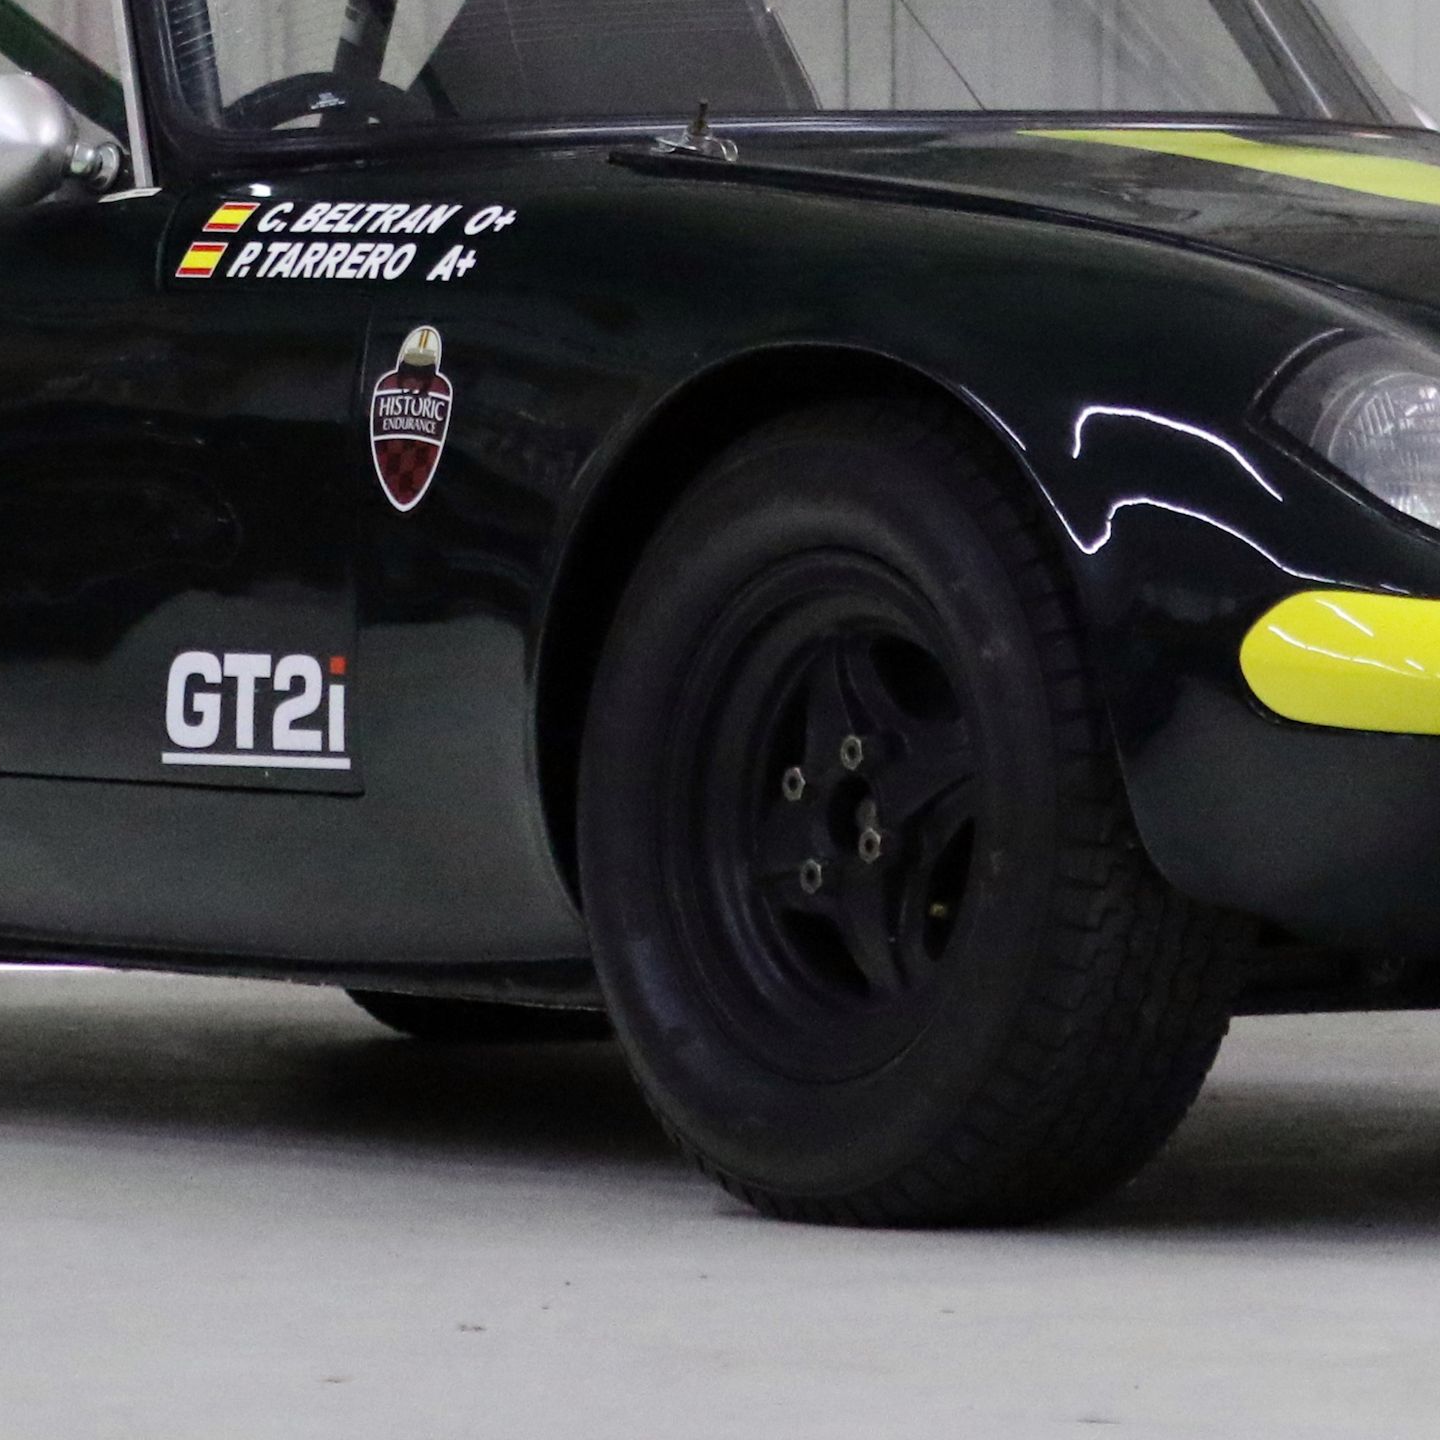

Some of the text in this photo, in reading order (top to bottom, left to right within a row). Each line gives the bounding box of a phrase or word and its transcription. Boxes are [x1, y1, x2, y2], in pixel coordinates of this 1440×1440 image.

[425, 245, 477, 281] A+
[379, 396, 445, 421] HISTORIC
[383, 417, 437, 434] ENDURANCE
[165, 650, 347, 752] GT2i
